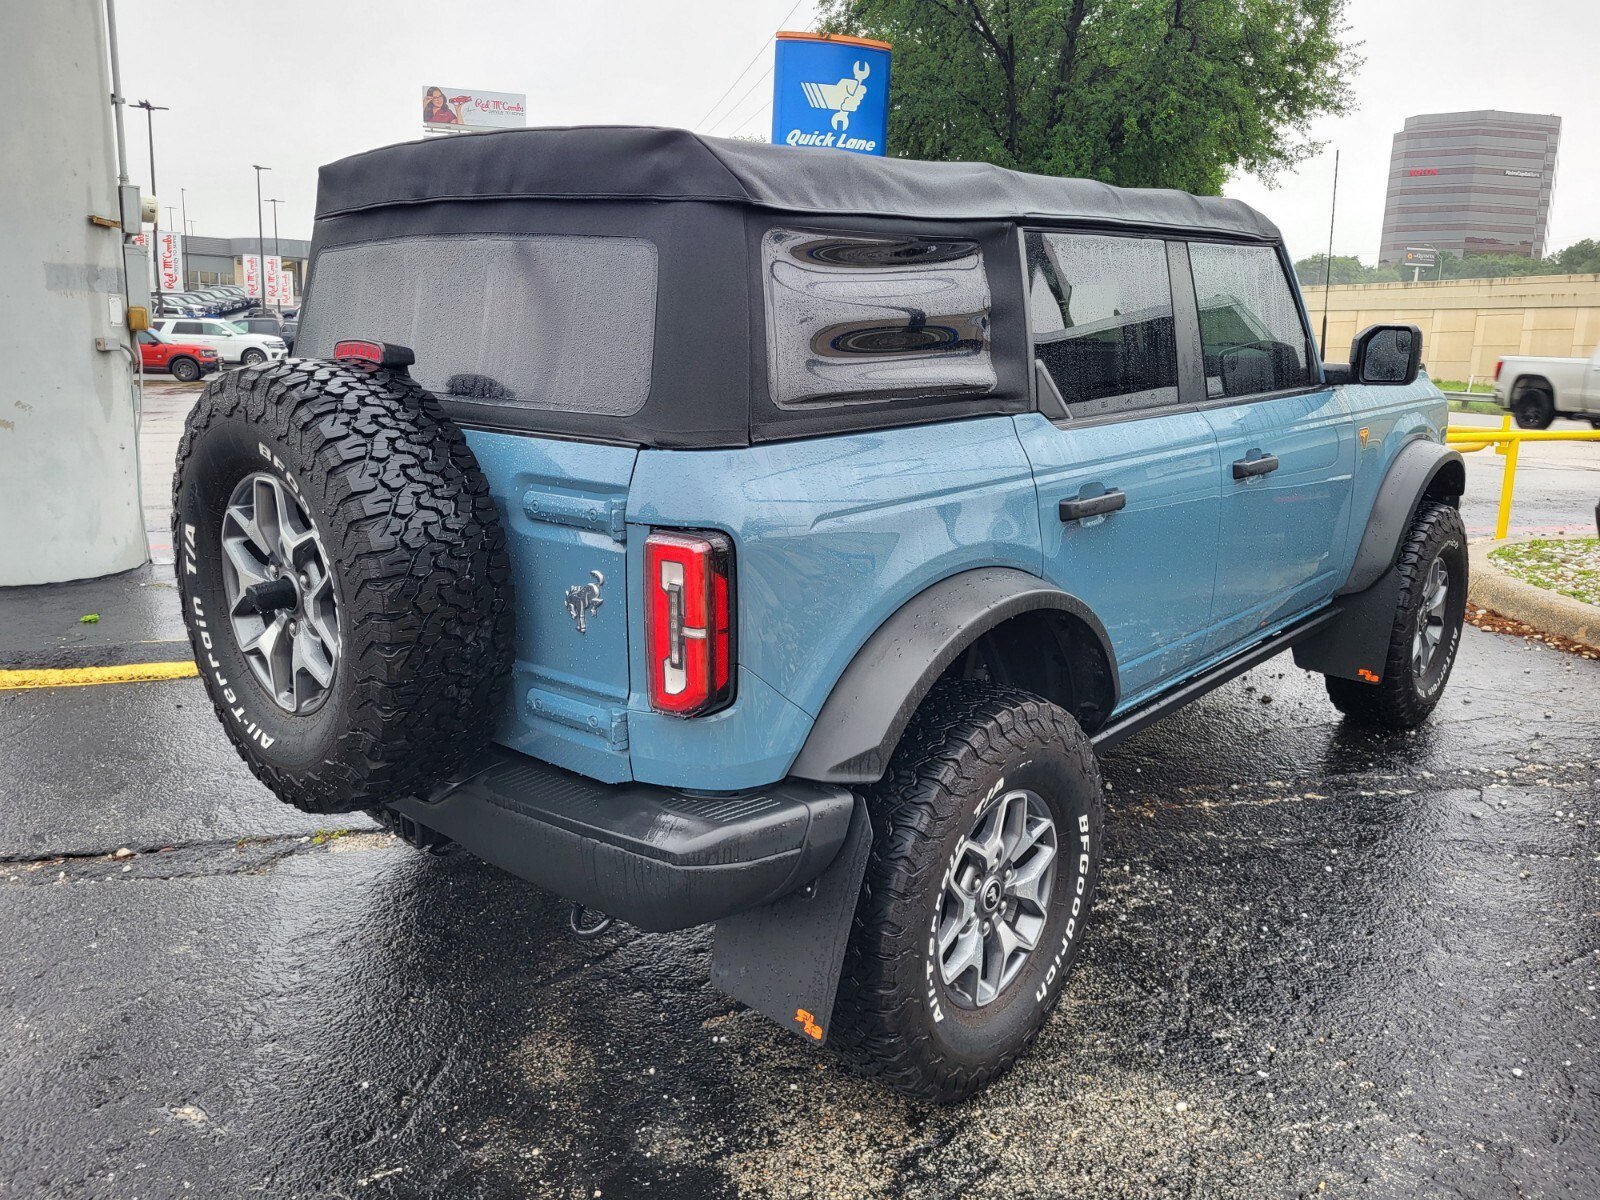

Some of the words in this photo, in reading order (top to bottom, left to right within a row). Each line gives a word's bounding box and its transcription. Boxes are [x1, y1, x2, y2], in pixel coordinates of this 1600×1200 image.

[475, 98, 490, 112] Red
[786, 129, 836, 147] Quick
[836, 133, 876, 151] Lane
[163, 272, 178, 289] Red
[184, 523, 197, 575] T/A
[192, 596, 275, 750] All-Terrain
[973, 777, 1005, 817] T/A
[1035, 814, 1090, 1003] BFGoodrich
